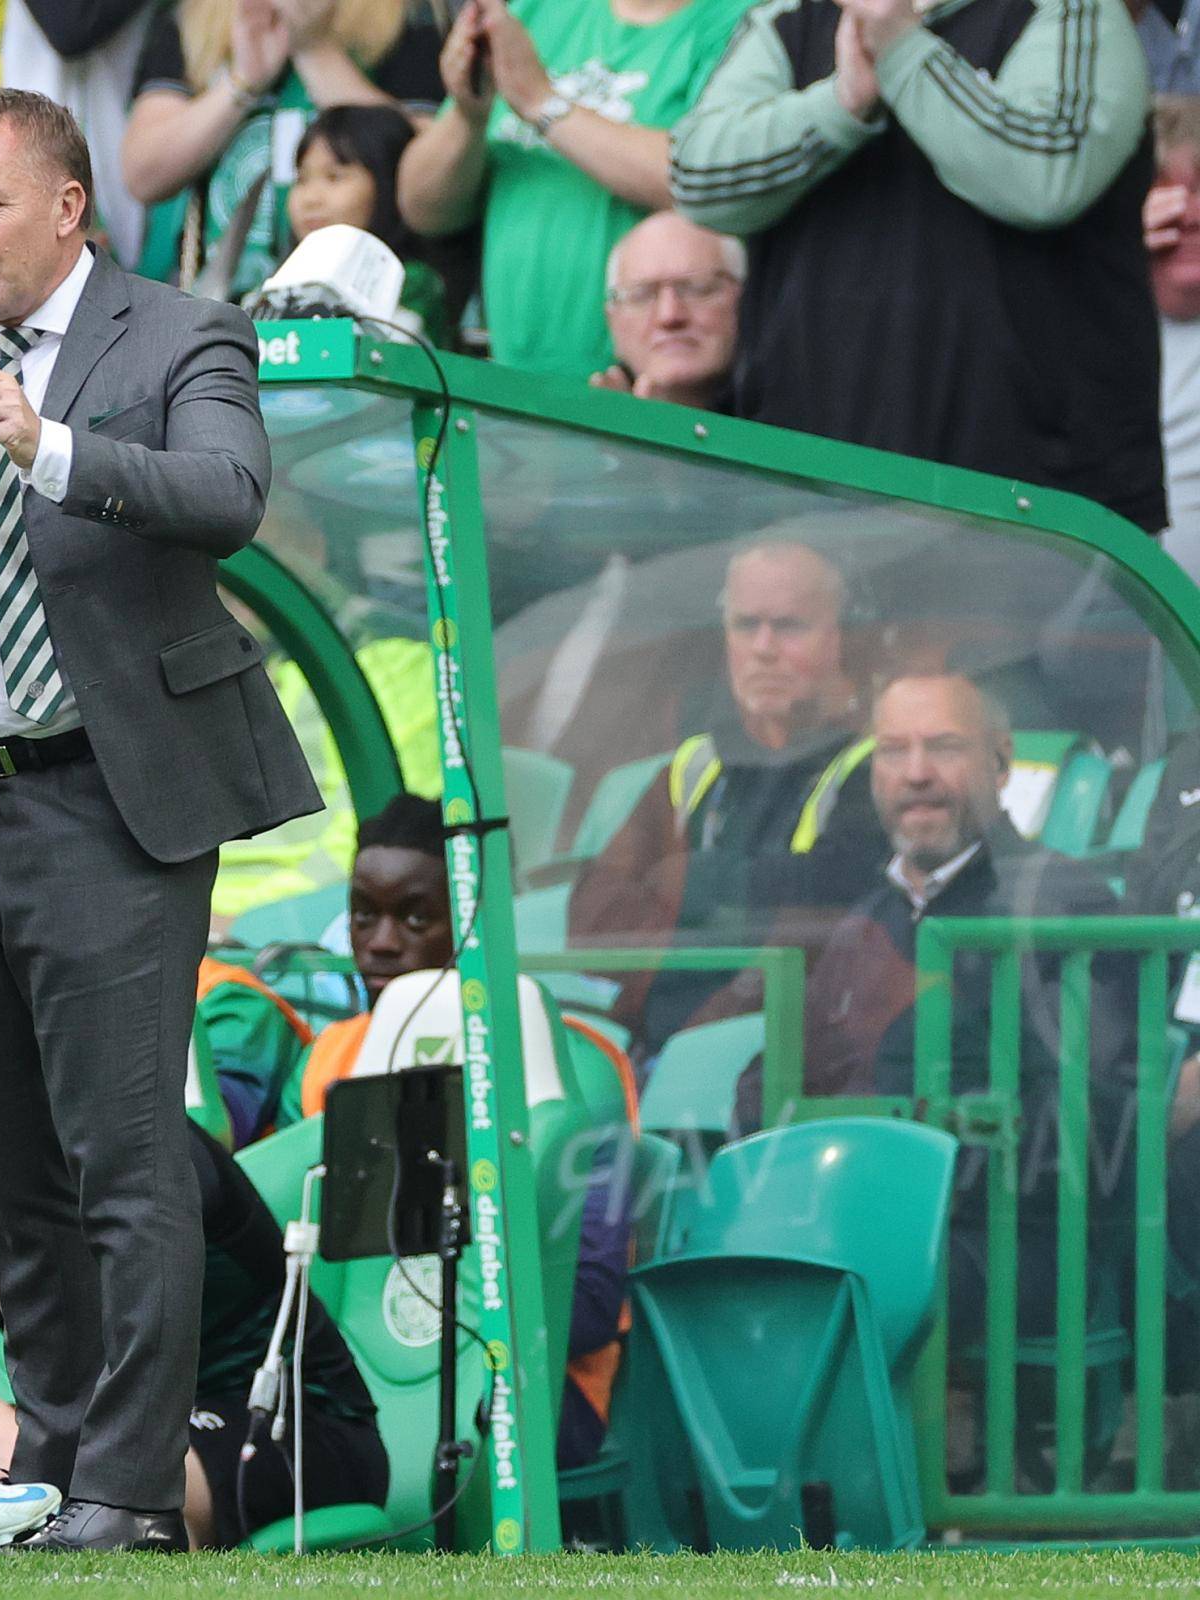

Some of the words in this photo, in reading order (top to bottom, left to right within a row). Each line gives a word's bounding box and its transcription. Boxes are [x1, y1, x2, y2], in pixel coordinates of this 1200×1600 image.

[466, 1013, 493, 1130] dafabet
[474, 1193, 503, 1310] dafabet
[490, 1373, 517, 1489] dafabet
